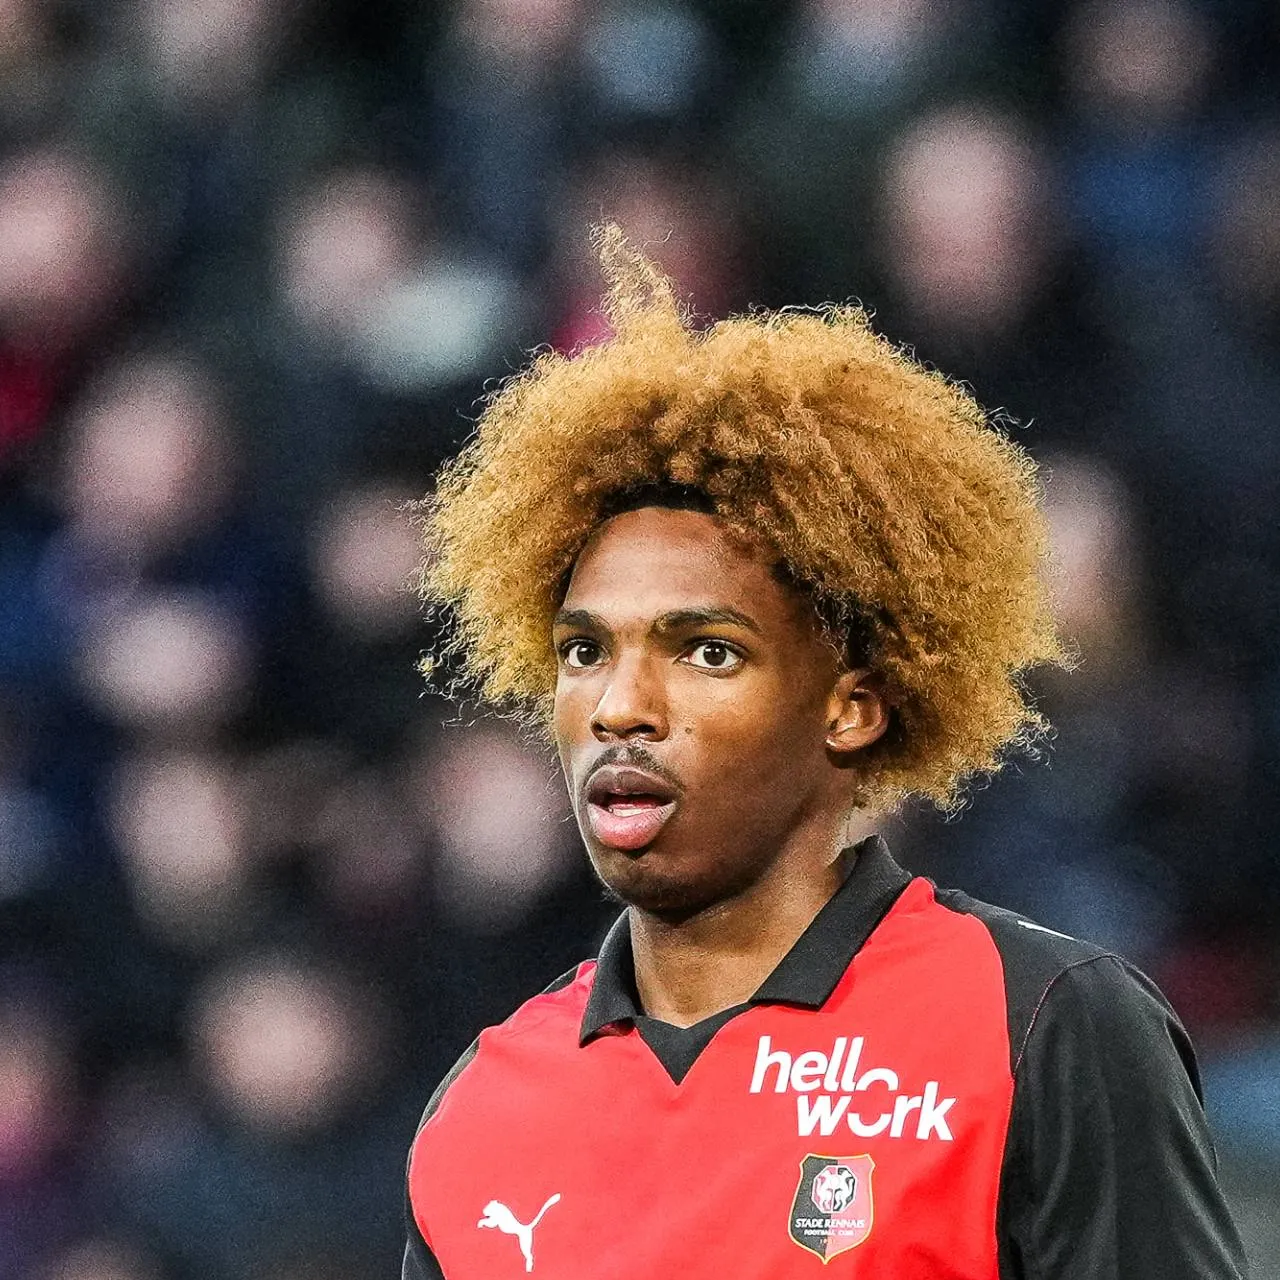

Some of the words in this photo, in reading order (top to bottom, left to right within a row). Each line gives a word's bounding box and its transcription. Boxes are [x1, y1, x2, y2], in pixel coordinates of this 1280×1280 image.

[749, 1035, 899, 1093] hello
[796, 1081, 957, 1141] work
[795, 1218, 824, 1228] STADE
[824, 1219, 865, 1228] RENNAIS
